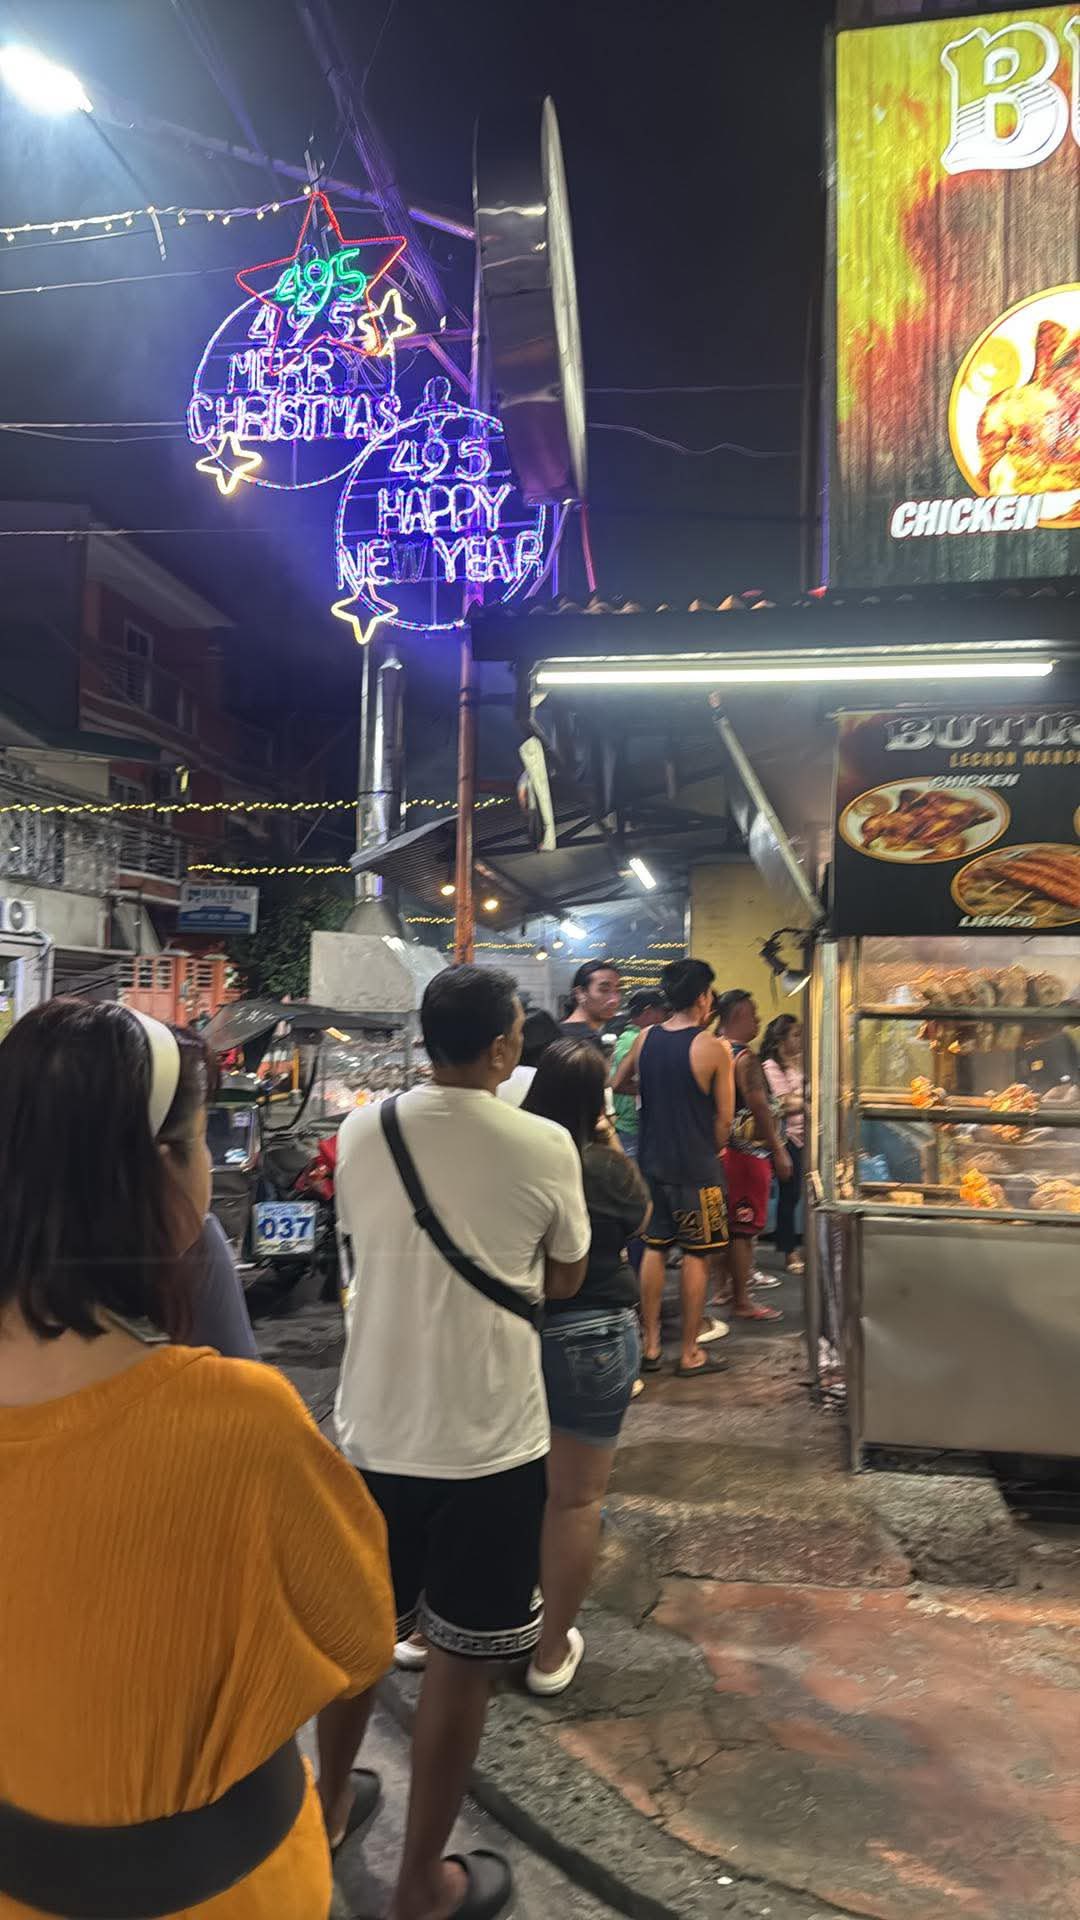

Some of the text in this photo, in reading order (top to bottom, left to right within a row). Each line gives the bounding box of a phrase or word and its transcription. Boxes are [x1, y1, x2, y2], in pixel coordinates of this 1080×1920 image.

[274, 247, 368, 316] 495
[247, 297, 356, 347] 495
[186, 393, 402, 444] CHRISTMAS
[389, 434, 493, 483] 495
[377, 484, 515, 536] HAPPY
[889, 496, 1042, 540] CHICKEN
[431, 530, 545, 584] YEAR
[929, 773, 1021, 789] CHICKEN
[957, 915, 1038, 928] LIEMPO
